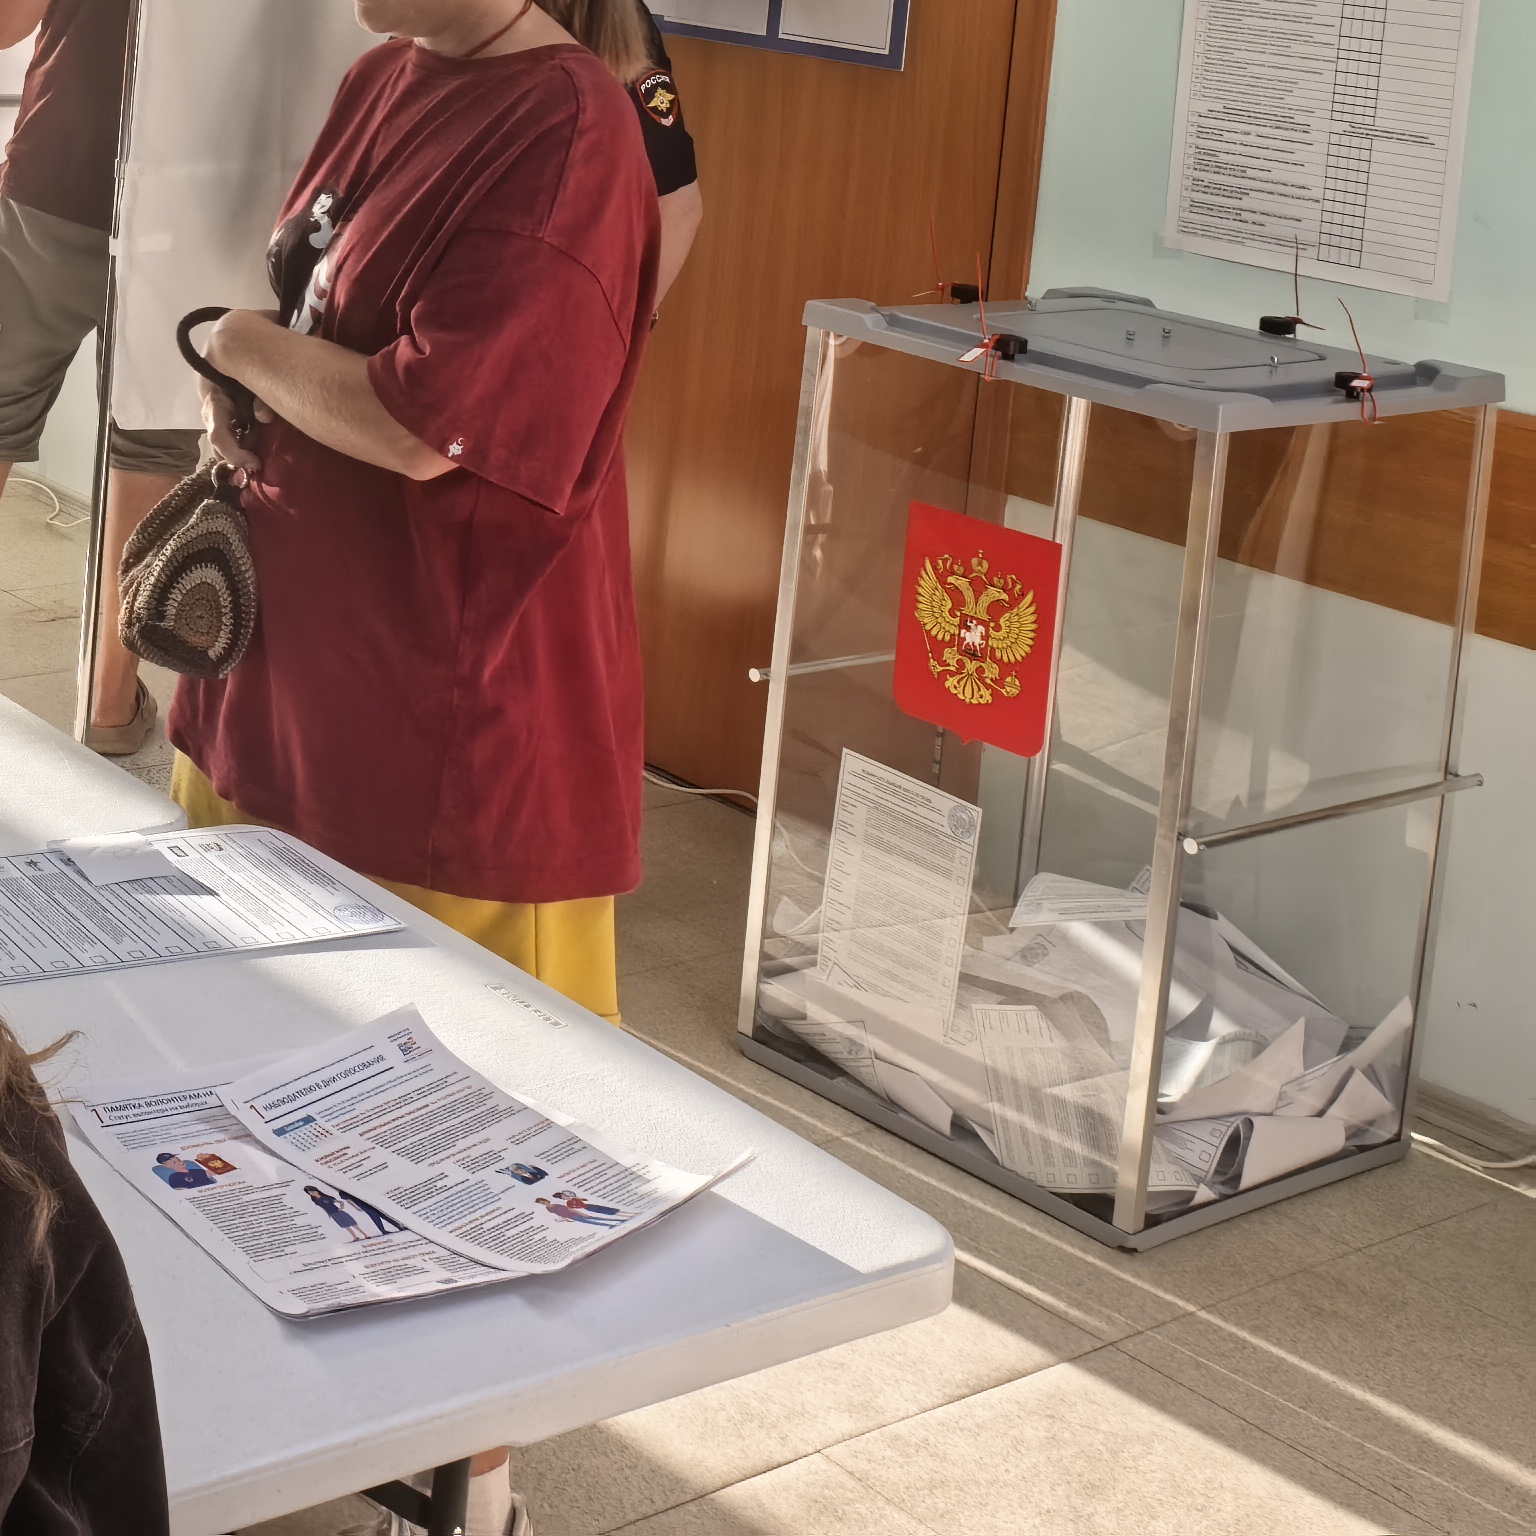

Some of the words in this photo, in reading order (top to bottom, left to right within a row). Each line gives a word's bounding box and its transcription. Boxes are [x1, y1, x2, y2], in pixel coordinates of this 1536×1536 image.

[262, 1079, 316, 1112] НАБЛЮДАТЕЛЮ
[321, 1074, 337, 1089] ДНИ
[335, 1053, 387, 1082] ГОЛОСОВАНИЯ
[102, 1101, 145, 1114] ПАМЯТКА
[144, 1091, 201, 1109] ВОЛОНТЕРАМ
[108, 1112, 132, 1122] Статус
[133, 1106, 169, 1118] волонтера
